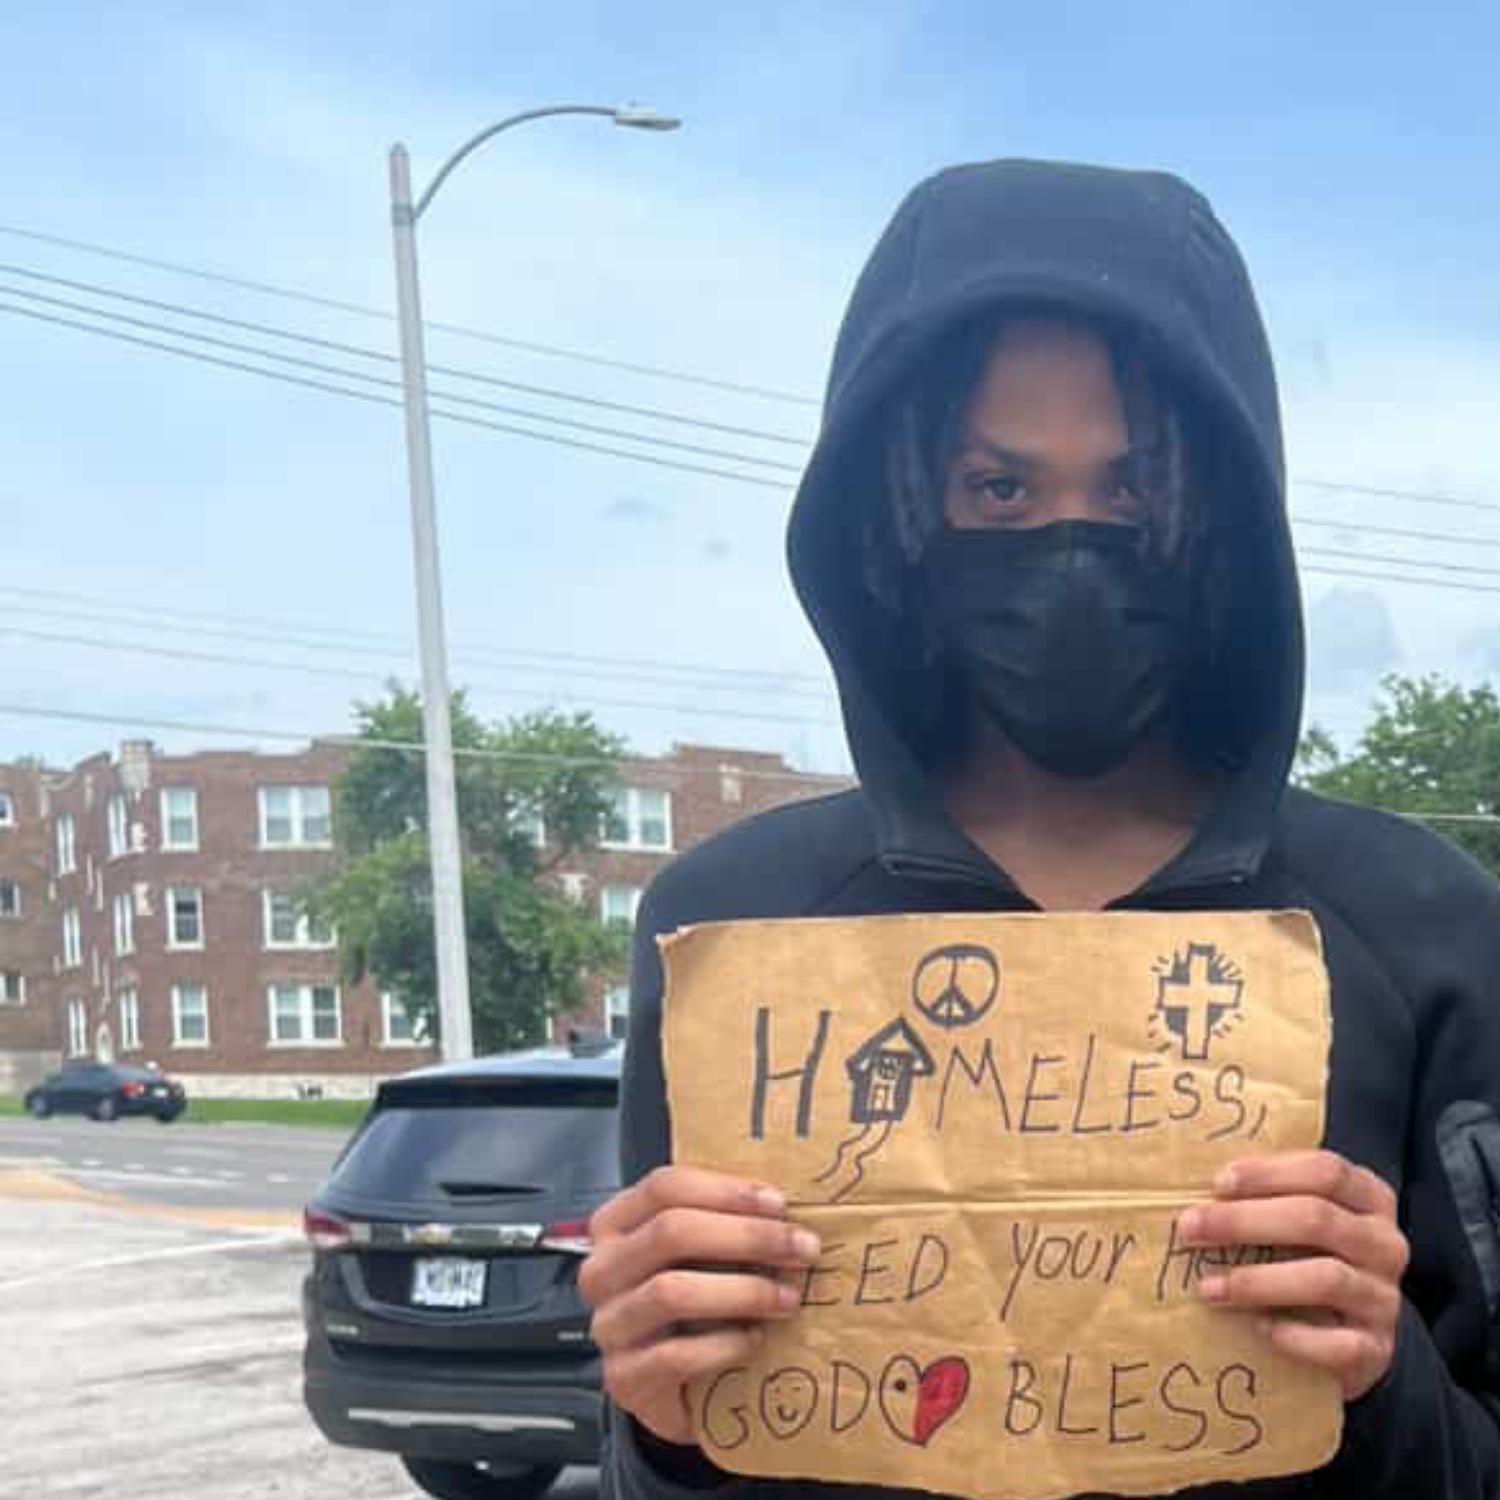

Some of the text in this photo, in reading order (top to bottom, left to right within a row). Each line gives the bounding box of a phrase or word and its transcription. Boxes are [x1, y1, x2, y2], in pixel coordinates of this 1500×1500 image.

[748, 1006, 1268, 1142] HMELESS,
[799, 1233, 948, 1307] EED
[701, 1354, 1264, 1454] GOD BLESS
